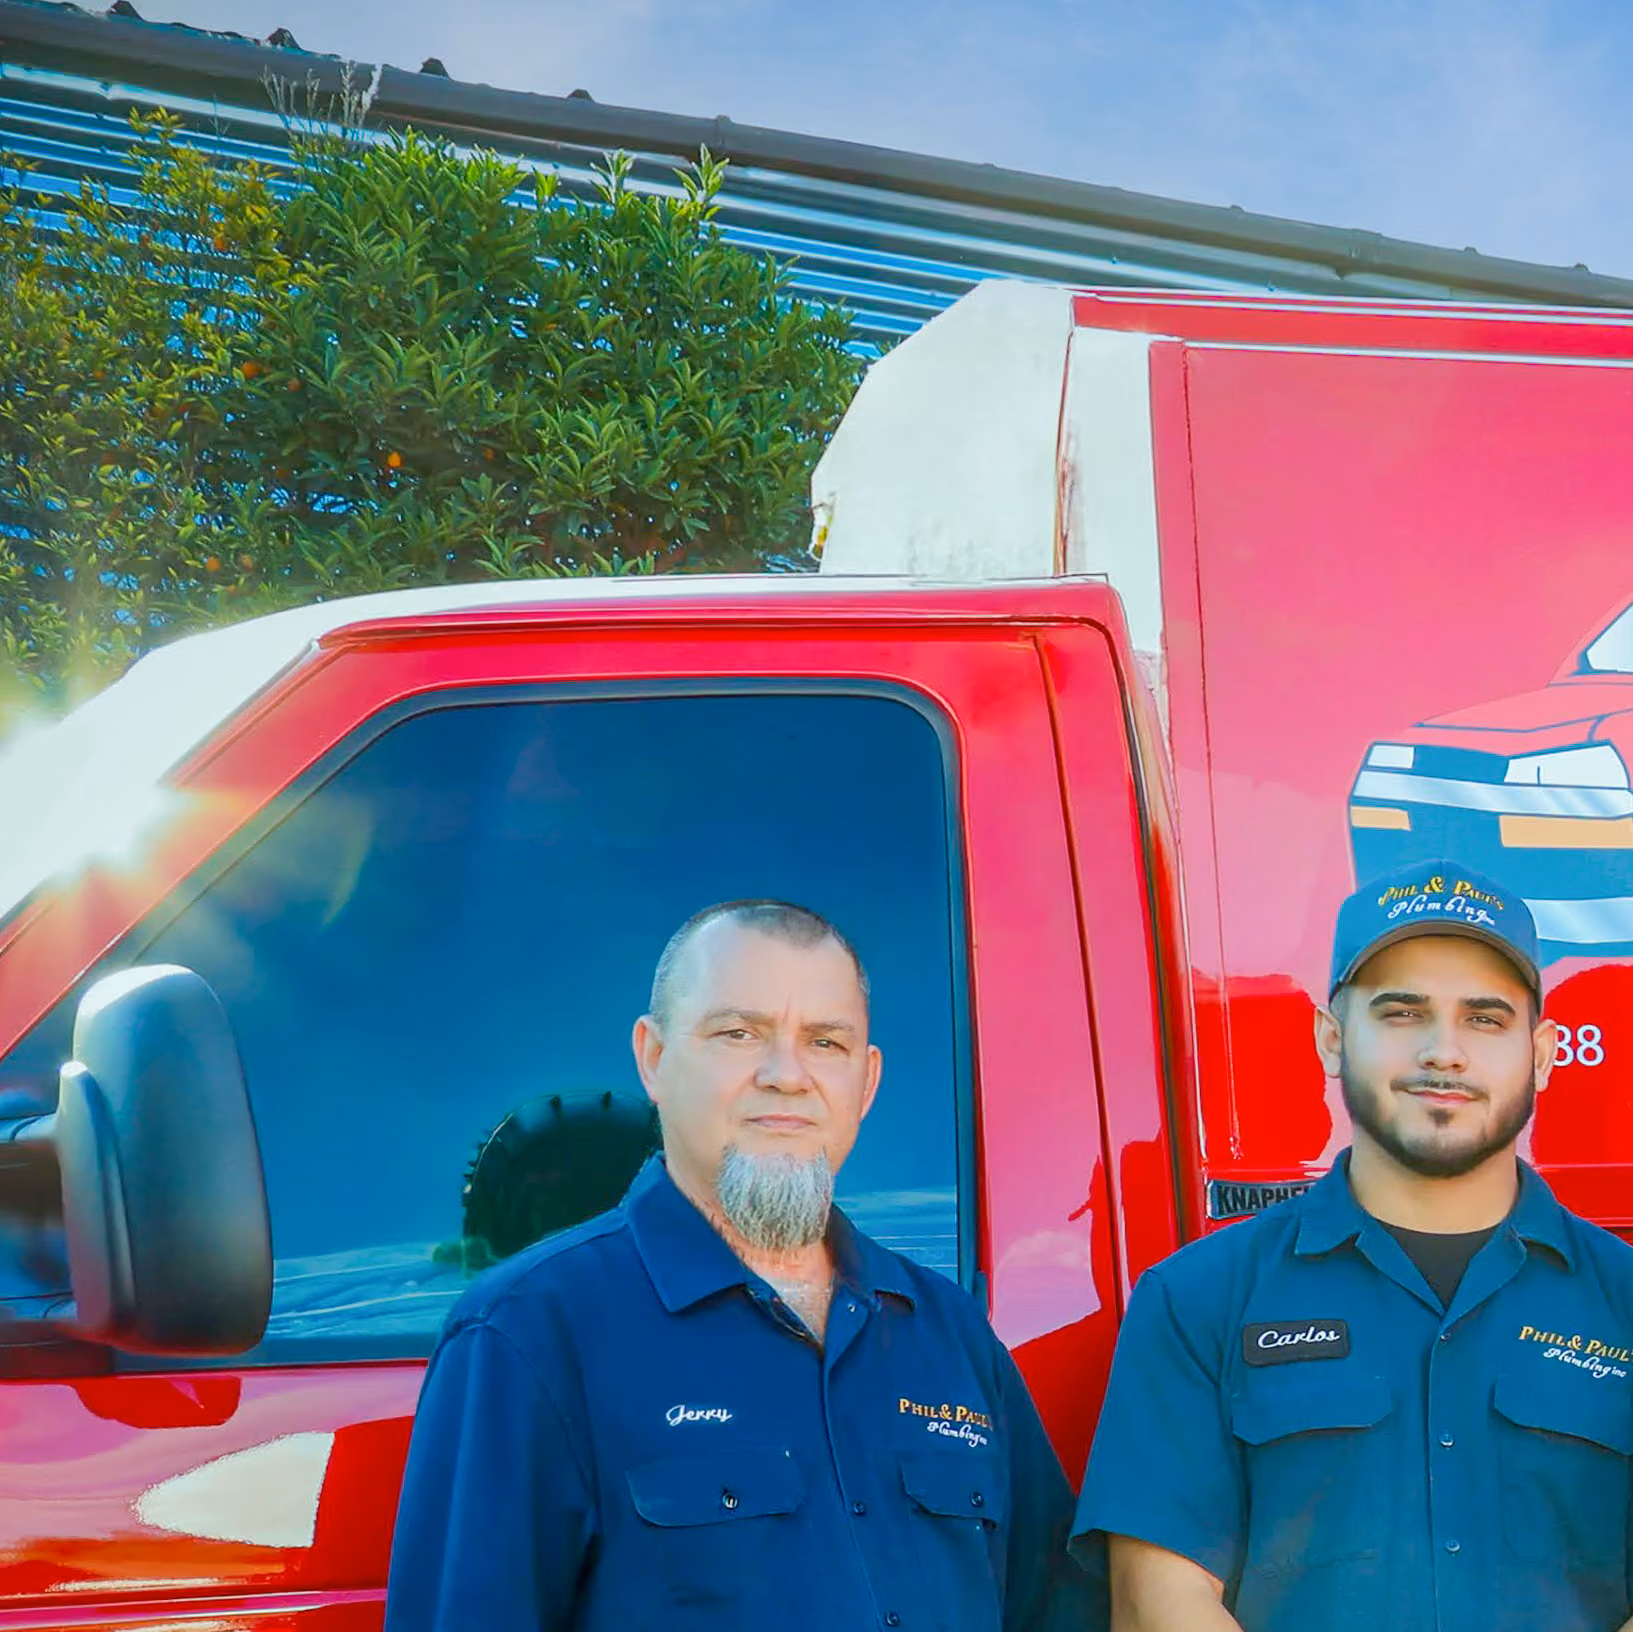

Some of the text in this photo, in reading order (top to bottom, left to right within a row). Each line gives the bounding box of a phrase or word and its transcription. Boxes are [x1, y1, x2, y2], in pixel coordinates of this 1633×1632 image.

[1423, 876, 1443, 893] &
[1387, 894, 1489, 922] Plumbing
[1257, 1326, 1341, 1349] Carlos
[1519, 1326, 1565, 1346] PHIL
[1567, 1335, 1582, 1350] &
[1543, 1347, 1612, 1378] Plumbing
[665, 1404, 733, 1426] Jerry
[899, 1398, 938, 1418] PHIL
[939, 1403, 952, 1420] &
